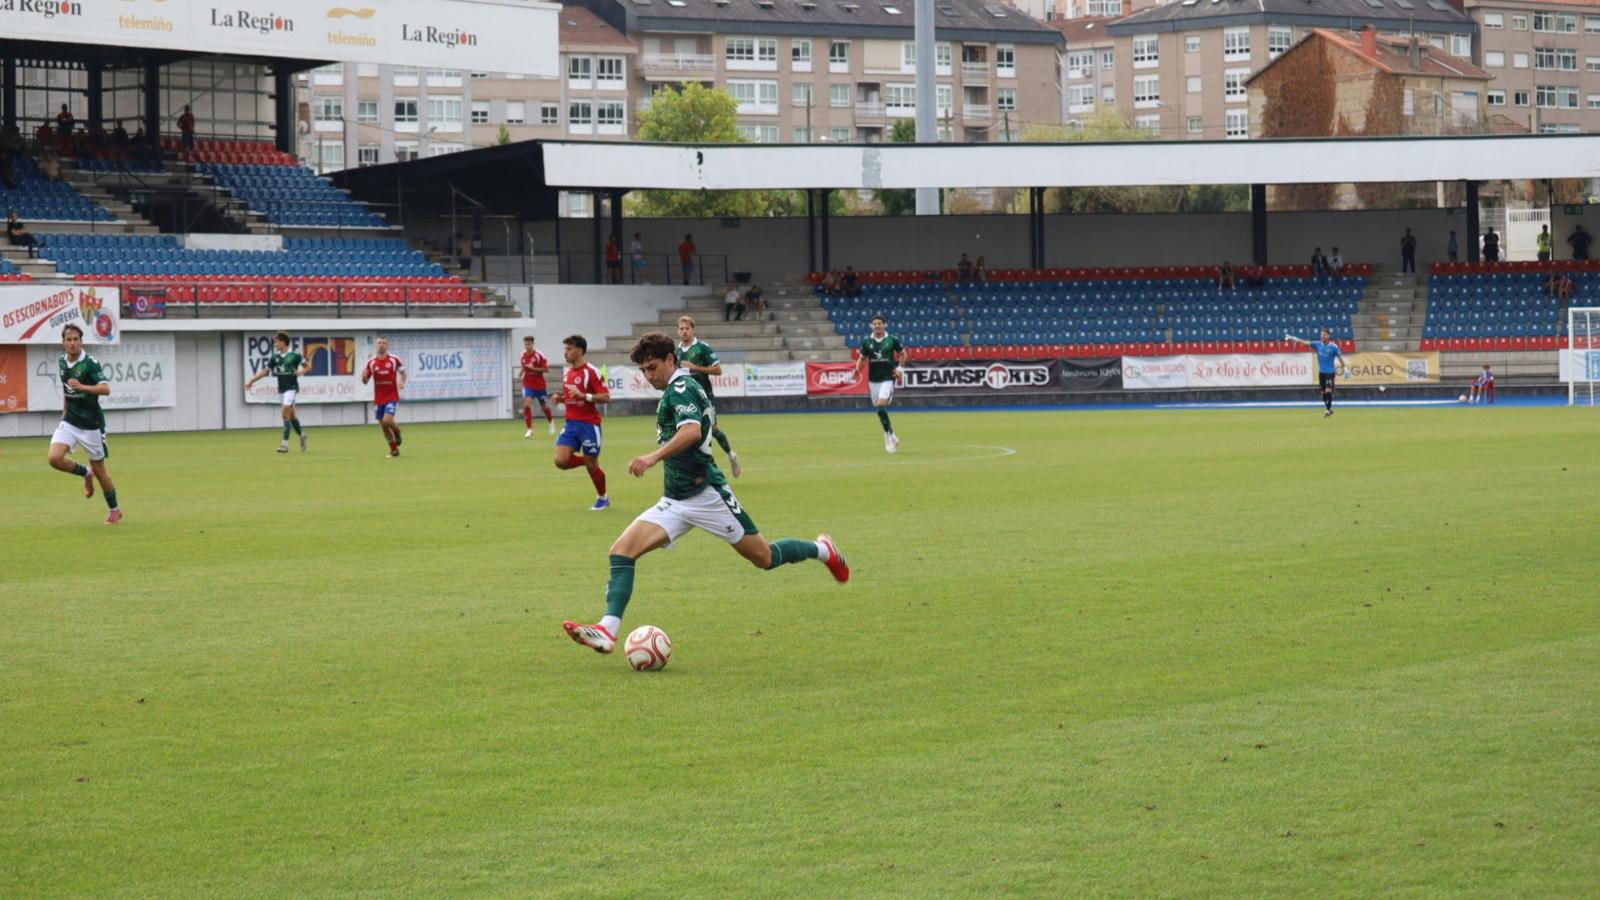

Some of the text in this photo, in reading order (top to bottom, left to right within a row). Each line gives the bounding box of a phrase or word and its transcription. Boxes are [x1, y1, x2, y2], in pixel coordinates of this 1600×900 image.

[118, 14, 173, 32] telemiño
[211, 8, 233, 27] La
[327, 31, 376, 47] telemiño
[402, 23, 422, 42] La
[16, 288, 75, 324] ESCORNABOYS
[50, 307, 79, 328] OURENSE
[418, 352, 464, 371] SOUSAS
[1351, 365, 1394, 376] GALEO
[102, 362, 162, 382] OSAGA
